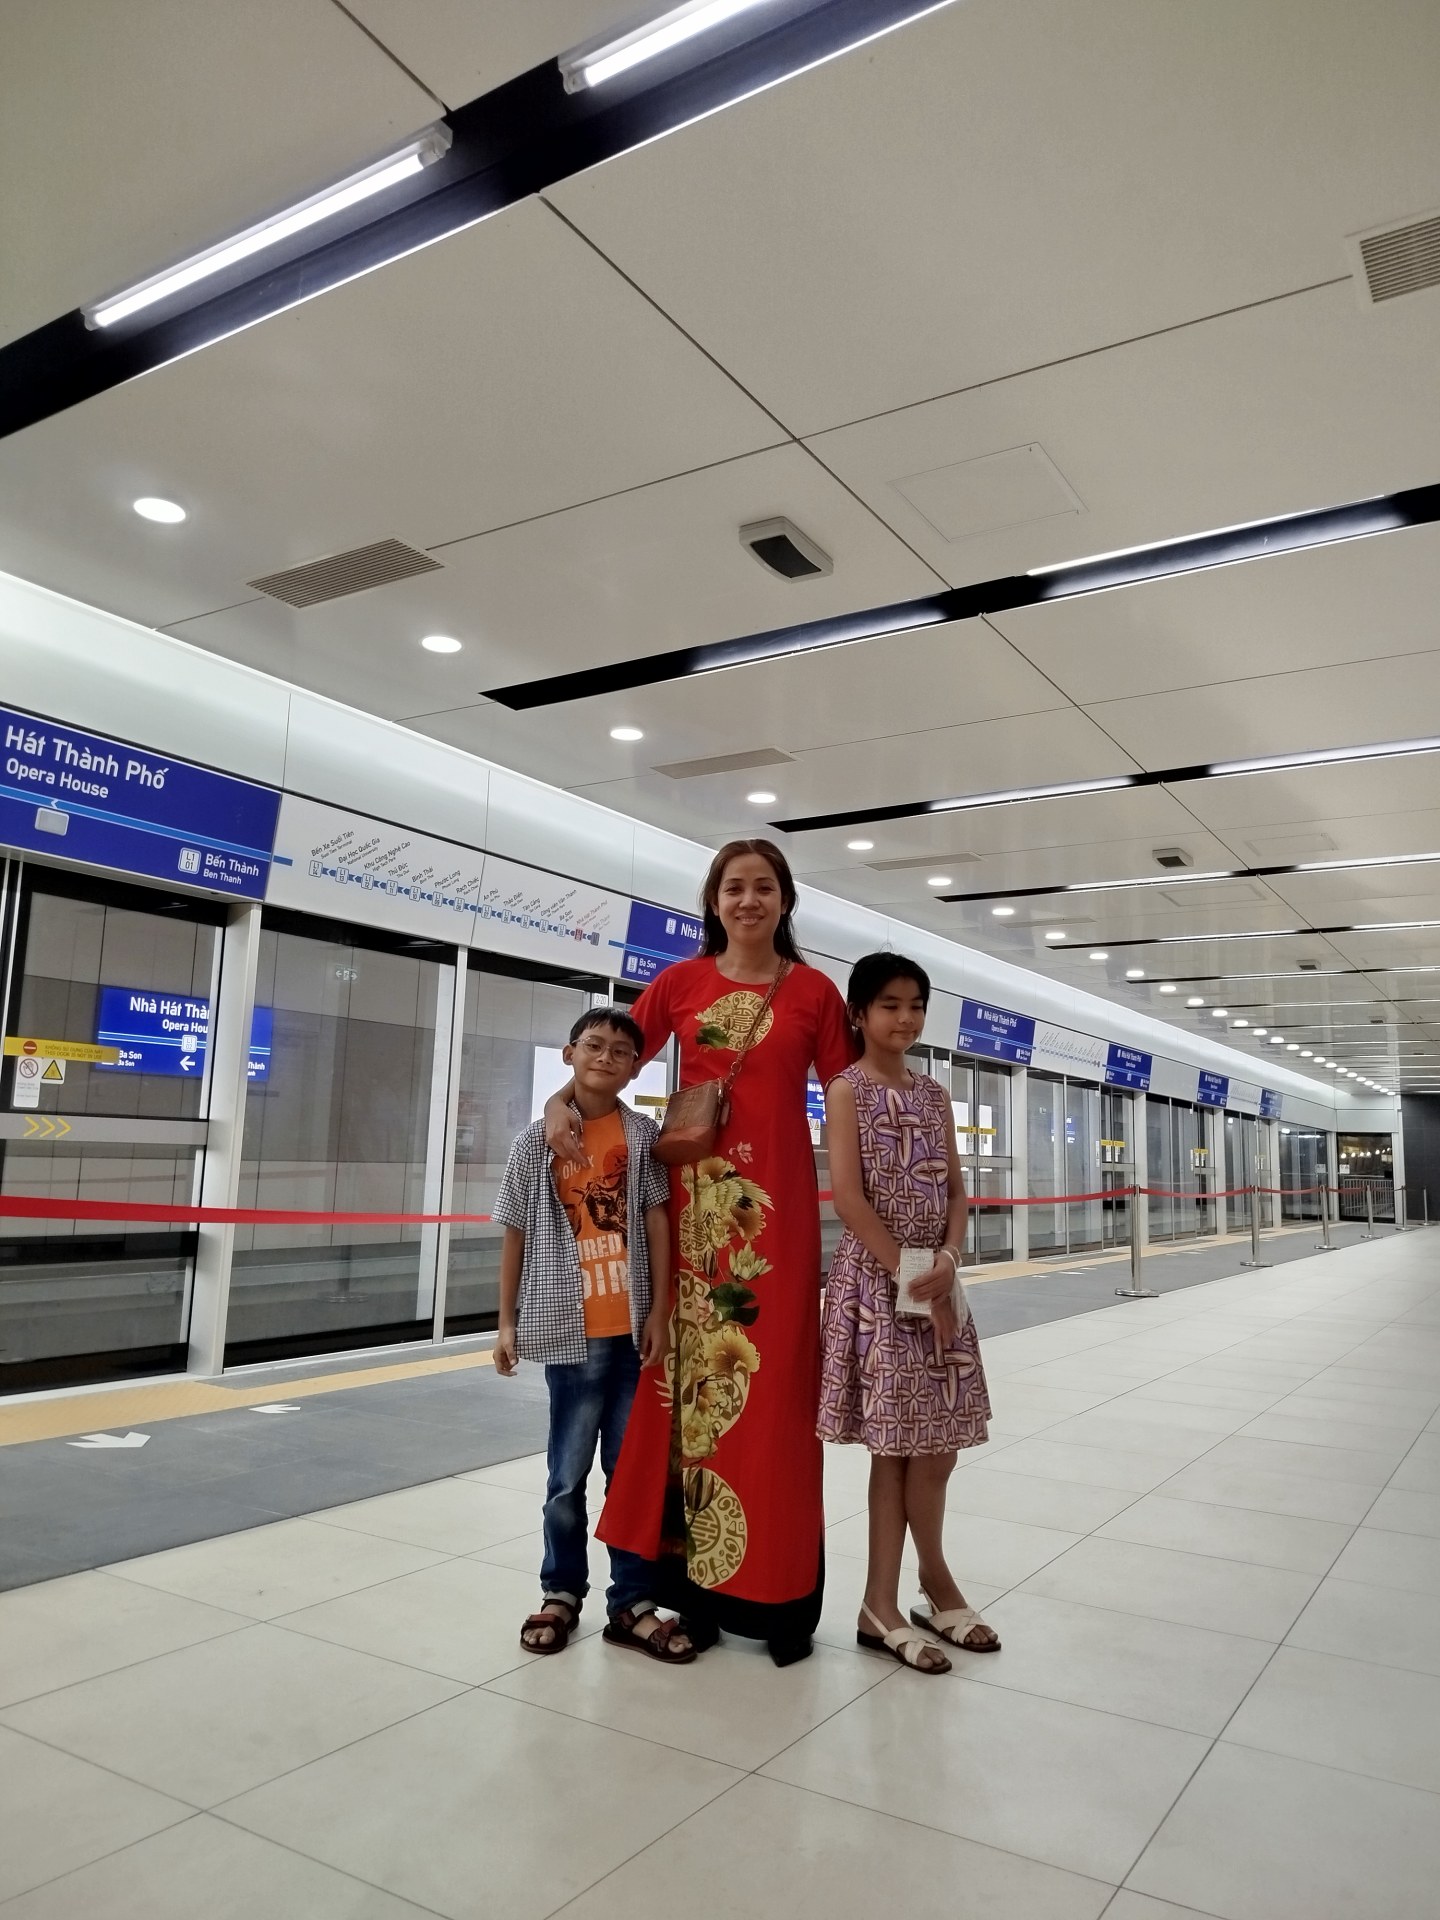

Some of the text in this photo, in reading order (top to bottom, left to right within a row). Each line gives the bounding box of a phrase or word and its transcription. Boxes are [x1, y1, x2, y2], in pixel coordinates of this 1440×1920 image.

[5, 725, 169, 790] Hát Thành Phố
[6, 758, 109, 798] Opera House
[186, 852, 195, 861] L1
[205, 853, 259, 877] Bến Thành
[185, 861, 194, 870] 01
[203, 868, 242, 885] Ben Thanh
[680, 922, 698, 940] Nhà
[130, 996, 210, 1020] Nhà Hát Thà
[162, 1019, 208, 1034] Opera Hou
[128, 1051, 142, 1060] Son
